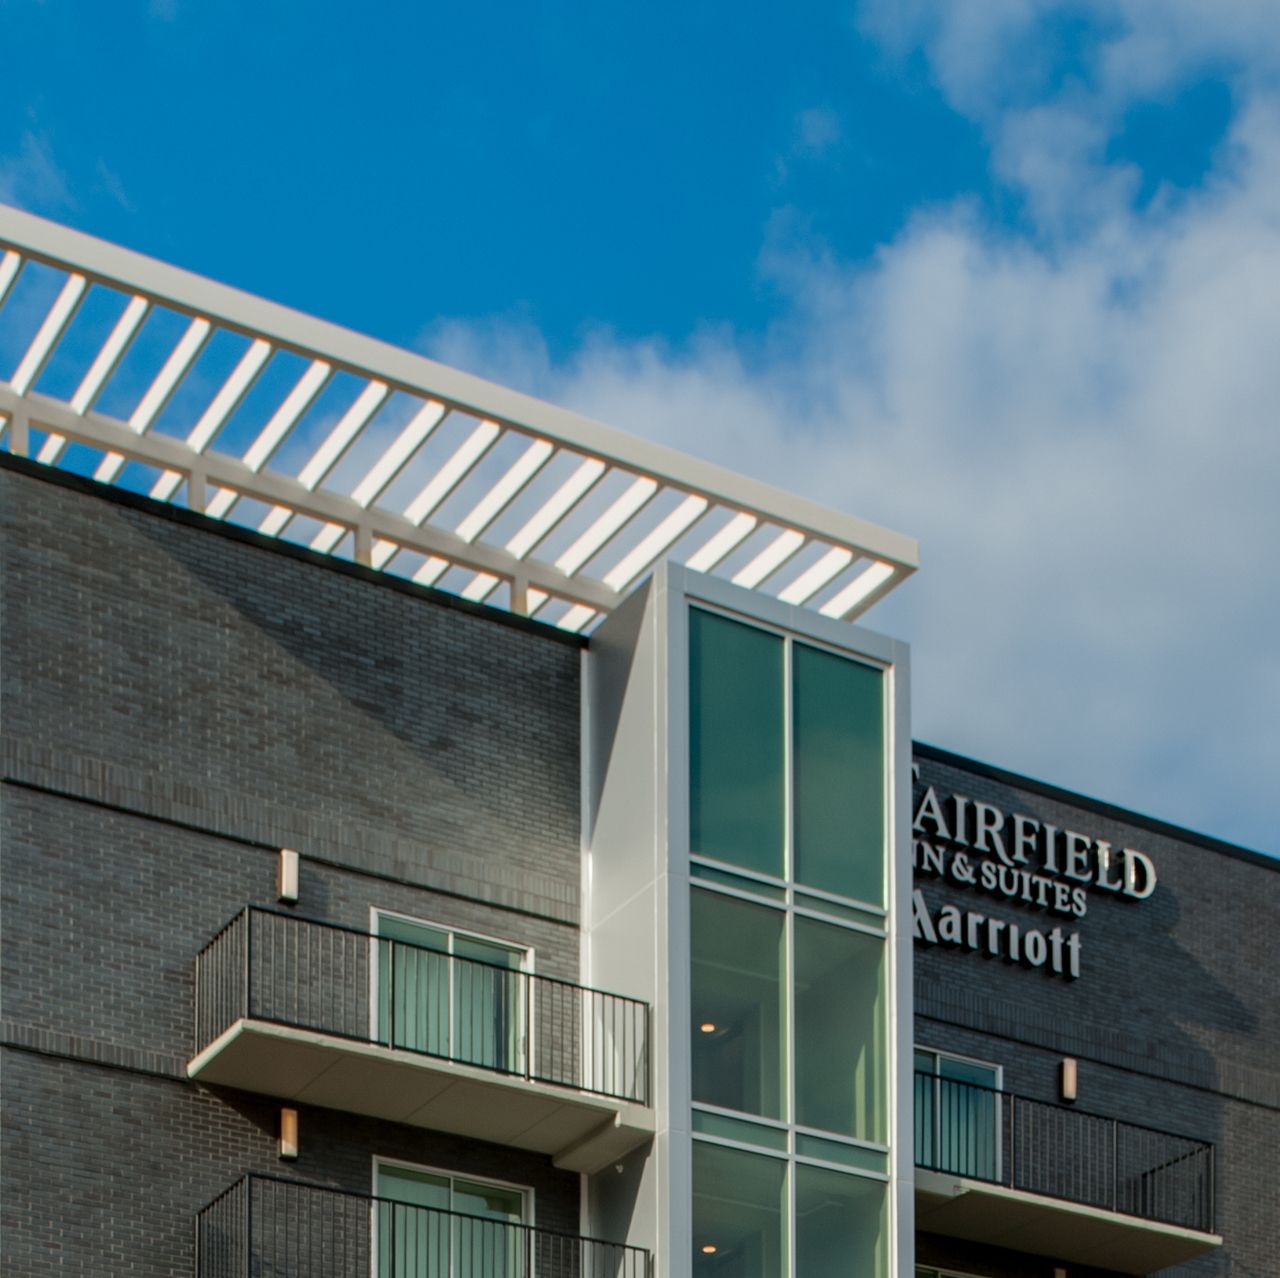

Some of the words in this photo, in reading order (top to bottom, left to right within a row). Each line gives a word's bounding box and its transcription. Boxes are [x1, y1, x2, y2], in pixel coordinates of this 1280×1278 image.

[912, 763, 1157, 900] AIRFIELD
[951, 855, 977, 885] &
[981, 863, 1088, 918] SUITES
